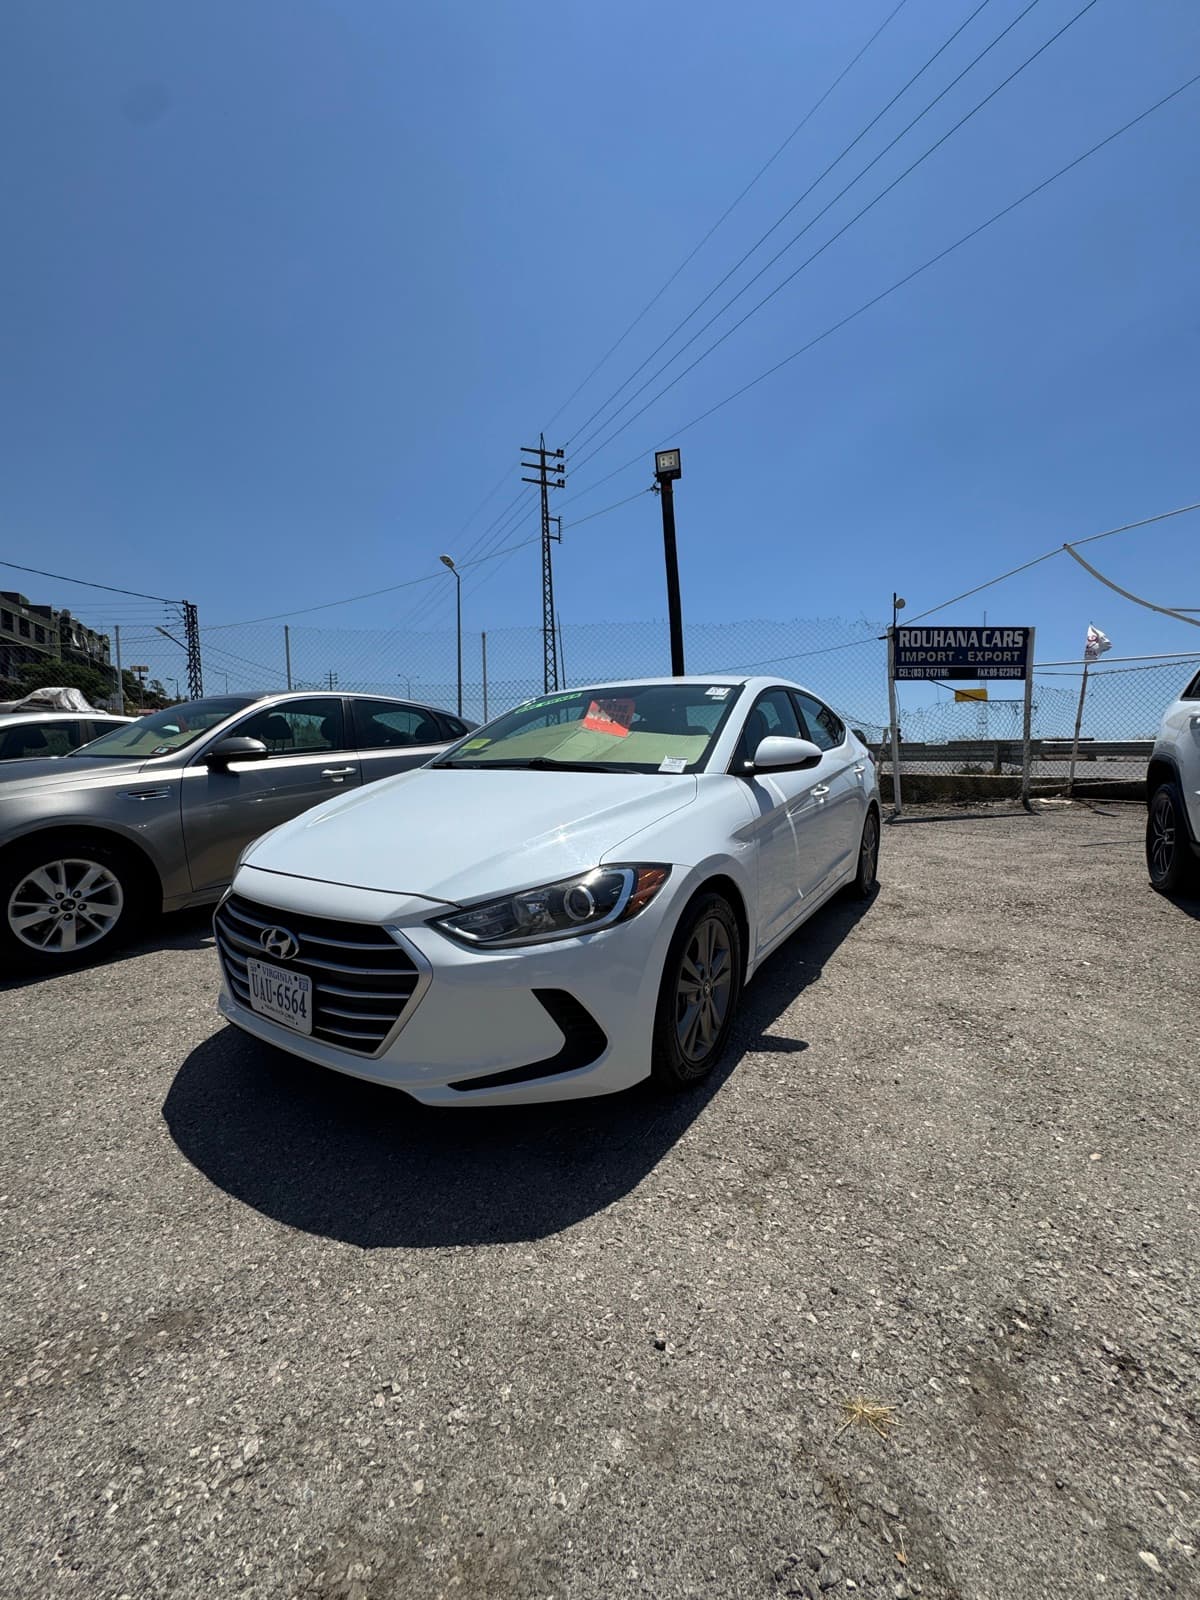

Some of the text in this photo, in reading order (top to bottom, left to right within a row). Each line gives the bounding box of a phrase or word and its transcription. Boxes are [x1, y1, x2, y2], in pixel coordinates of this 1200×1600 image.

[900, 630, 1024, 648] ROUHANA CARS
[901, 651, 955, 662] IMPORT
[967, 651, 1021, 662] EXPORT
[262, 966, 293, 985] VIRGINIA
[252, 973, 307, 1019] UAU-6564
